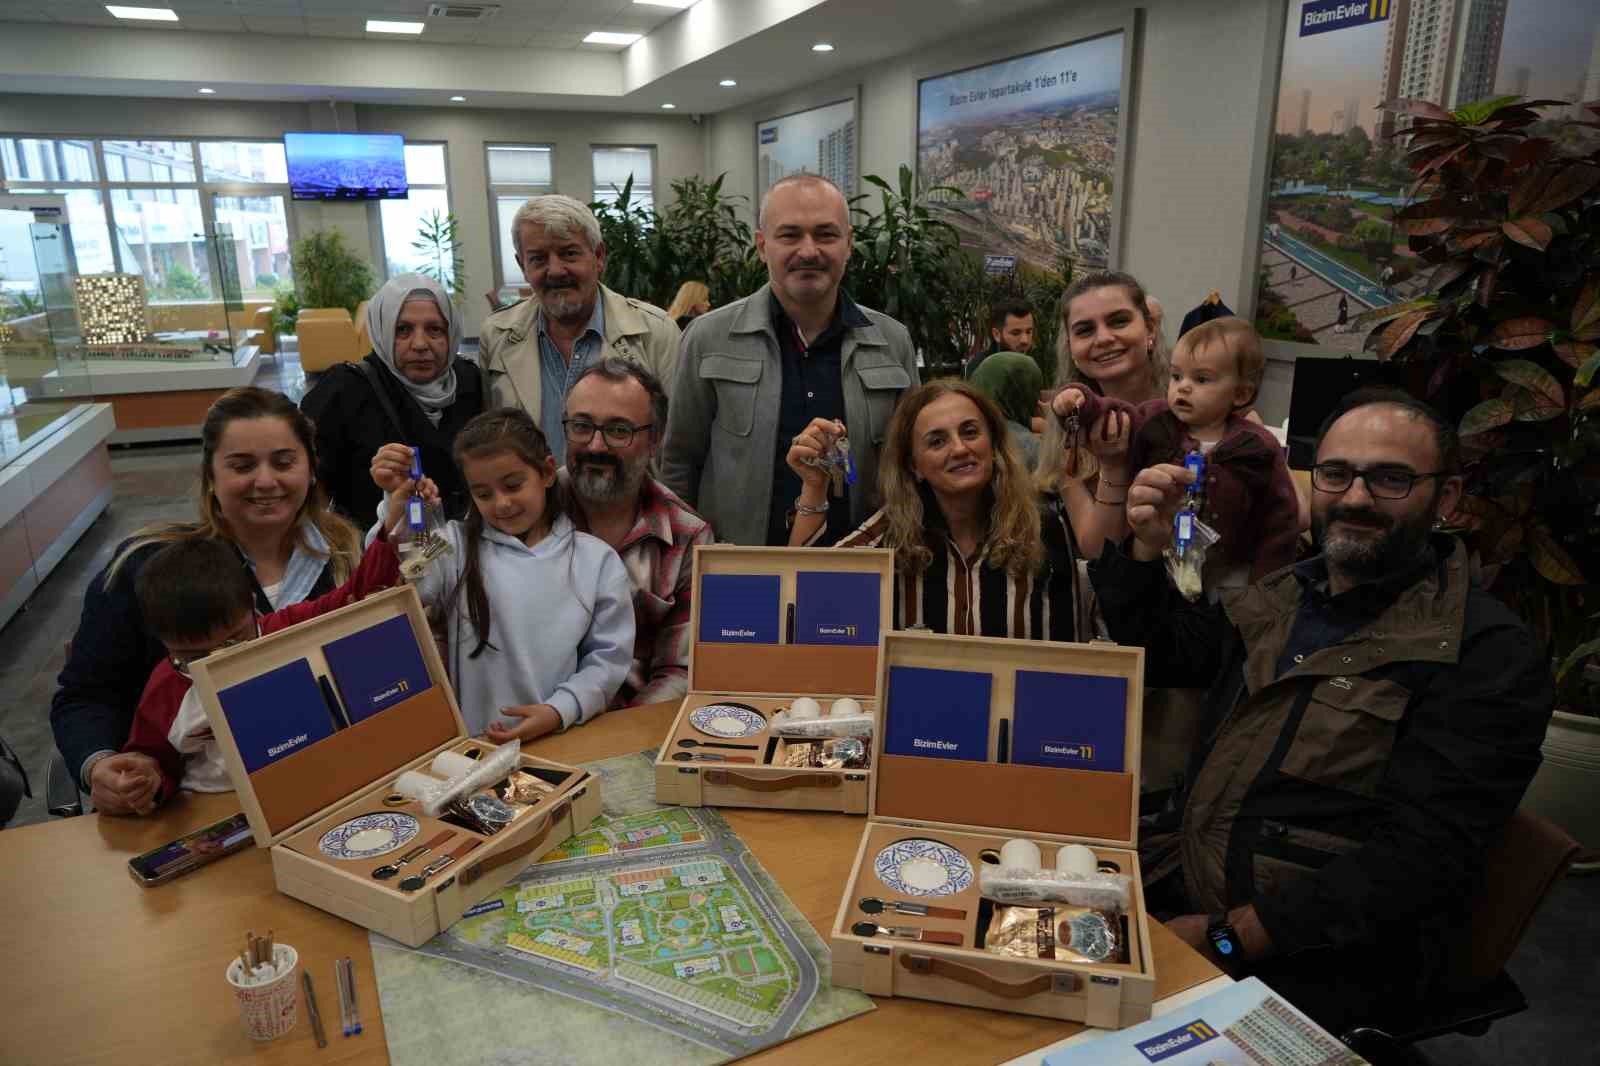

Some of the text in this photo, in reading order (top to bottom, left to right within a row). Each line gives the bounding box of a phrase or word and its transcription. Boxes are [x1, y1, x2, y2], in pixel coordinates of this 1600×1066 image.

[1304, 2, 1368, 26] BizimEvler
[969, 90, 988, 102] Evler
[1034, 75, 1057, 89] 1'den
[1060, 70, 1077, 85] 11'e
[721, 628, 756, 638] BizimEvler
[846, 626, 856, 636] 11
[398, 680, 409, 692] 11
[267, 733, 308, 757] BizimEvler
[913, 738, 959, 751] BizimEvler
[1044, 745, 1092, 759] BizimEvler 11
[1143, 1023, 1215, 1056] BizimEvler 11
